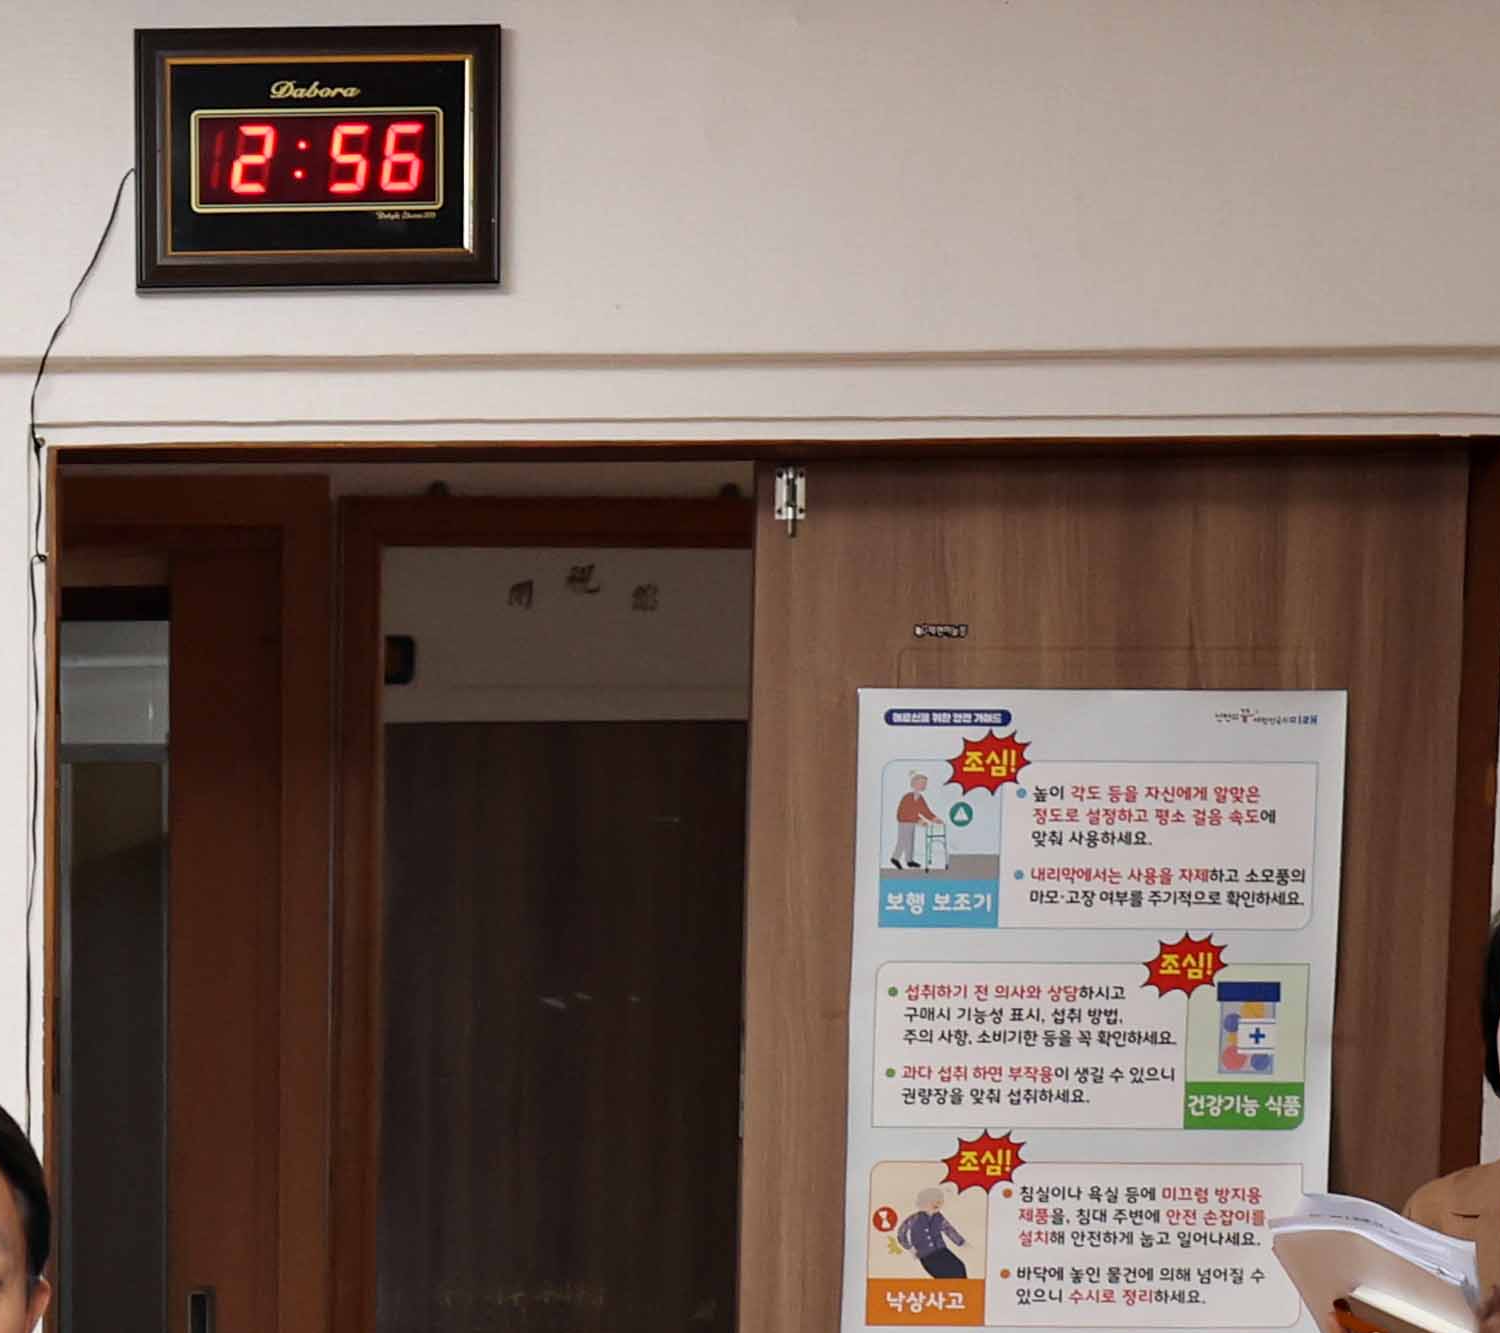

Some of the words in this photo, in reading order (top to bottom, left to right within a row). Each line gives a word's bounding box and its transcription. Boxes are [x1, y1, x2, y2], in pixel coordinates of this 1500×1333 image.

[269, 80, 361, 100] Dabora
[230, 121, 426, 194] 2:56
[963, 750, 1017, 778] 조심!
[1032, 785, 1065, 803] 높이
[1071, 785, 1101, 802] 각도
[1107, 784, 1139, 804] 등을
[1144, 785, 1208, 804] 자신에게
[1213, 785, 1261, 804] 알맞은
[1032, 807, 1080, 826] 정도로
[1085, 807, 1149, 826] 설정하고
[1154, 808, 1186, 826] 평소
[1192, 807, 1224, 827] 걸음
[1228, 808, 1277, 826] 속도에
[1031, 830, 1063, 848] 맞춰
[1068, 830, 1153, 849] 사용하세요.
[1030, 867, 1122, 885] 내리막에서는
[1127, 867, 1174, 886] 사용을
[1179, 867, 1240, 883] 자제하고
[1244, 868, 1306, 887] 소모품의
[885, 891, 926, 916] 보행
[932, 892, 992, 913] 보조기
[1099, 890, 1144, 908] 여부를
[1147, 890, 1222, 908] 주기적으로
[1226, 889, 1305, 909] 확인하세요.
[1157, 949, 1216, 981] 조심!
[904, 983, 968, 1002] 섭취하기
[973, 984, 989, 1002] 전
[994, 984, 1043, 1001] 의사와
[1047, 984, 1126, 1003] 상담하시고
[903, 1006, 951, 1023] 구매시
[957, 1007, 1004, 1025] 기능성
[1009, 1007, 1046, 1024] 표시,
[1050, 1007, 1082, 1025] 섭취
[1087, 1007, 1123, 1026] 방법,
[903, 1028, 934, 1045] 주의
[937, 1028, 973, 1047] 사항,
[976, 1029, 1039, 1048] 소비기한
[1041, 1029, 1073, 1048] 등을
[1076, 1030, 1093, 1048] 꼭
[1096, 1029, 1177, 1048] 확인하세요.
[902, 1065, 933, 1080] 과다
[937, 1065, 968, 1083] 섭취
[972, 1065, 1003, 1084] 하면
[1007, 1065, 1070, 1084] 부작용이
[1073, 1066, 1105, 1085] 생길
[1108, 1067, 1125, 1084] 수
[1128, 1066, 1176, 1085] 있으니
[901, 1087, 965, 1106] 권량장을
[969, 1087, 1001, 1105] 맞춰
[1007, 1088, 1090, 1106] 섭취하세요.
[1187, 1094, 1261, 1118] 건강기능
[1264, 1095, 1303, 1118] 식품
[955, 1147, 1015, 1178] 조심!
[1019, 1185, 1083, 1204] 침실이나
[1087, 1185, 1119, 1204] 욕실
[1124, 1186, 1157, 1205] 등에
[1161, 1186, 1209, 1205] 미끄럼
[1214, 1186, 1263, 1206] 방지용
[1018, 1207, 1071, 1226] 제품을,
[1076, 1207, 1108, 1226] 침대
[1112, 1208, 1161, 1227] 주변에
[1165, 1208, 1197, 1227] 안전
[1202, 1209, 1266, 1227] 손잡이를
[1019, 1230, 1065, 1248] 설치해
[1070, 1230, 1134, 1248] 안전하게
[1139, 1230, 1171, 1249] 눕고
[1176, 1231, 1261, 1249] 일어나세요.
[1016, 1266, 1064, 1284] 바닥에
[1069, 1266, 1101, 1285] 놓인
[1106, 1266, 1154, 1284] 물건에
[1159, 1267, 1191, 1282] 의해
[1196, 1267, 1244, 1285] 넘어질
[1250, 1268, 1265, 1284] 수
[886, 1291, 966, 1313] 낙상사고
[1015, 1288, 1063, 1305] 있으니
[1068, 1288, 1116, 1305] 수시로
[1122, 1288, 1206, 1307] 정리하세요.
